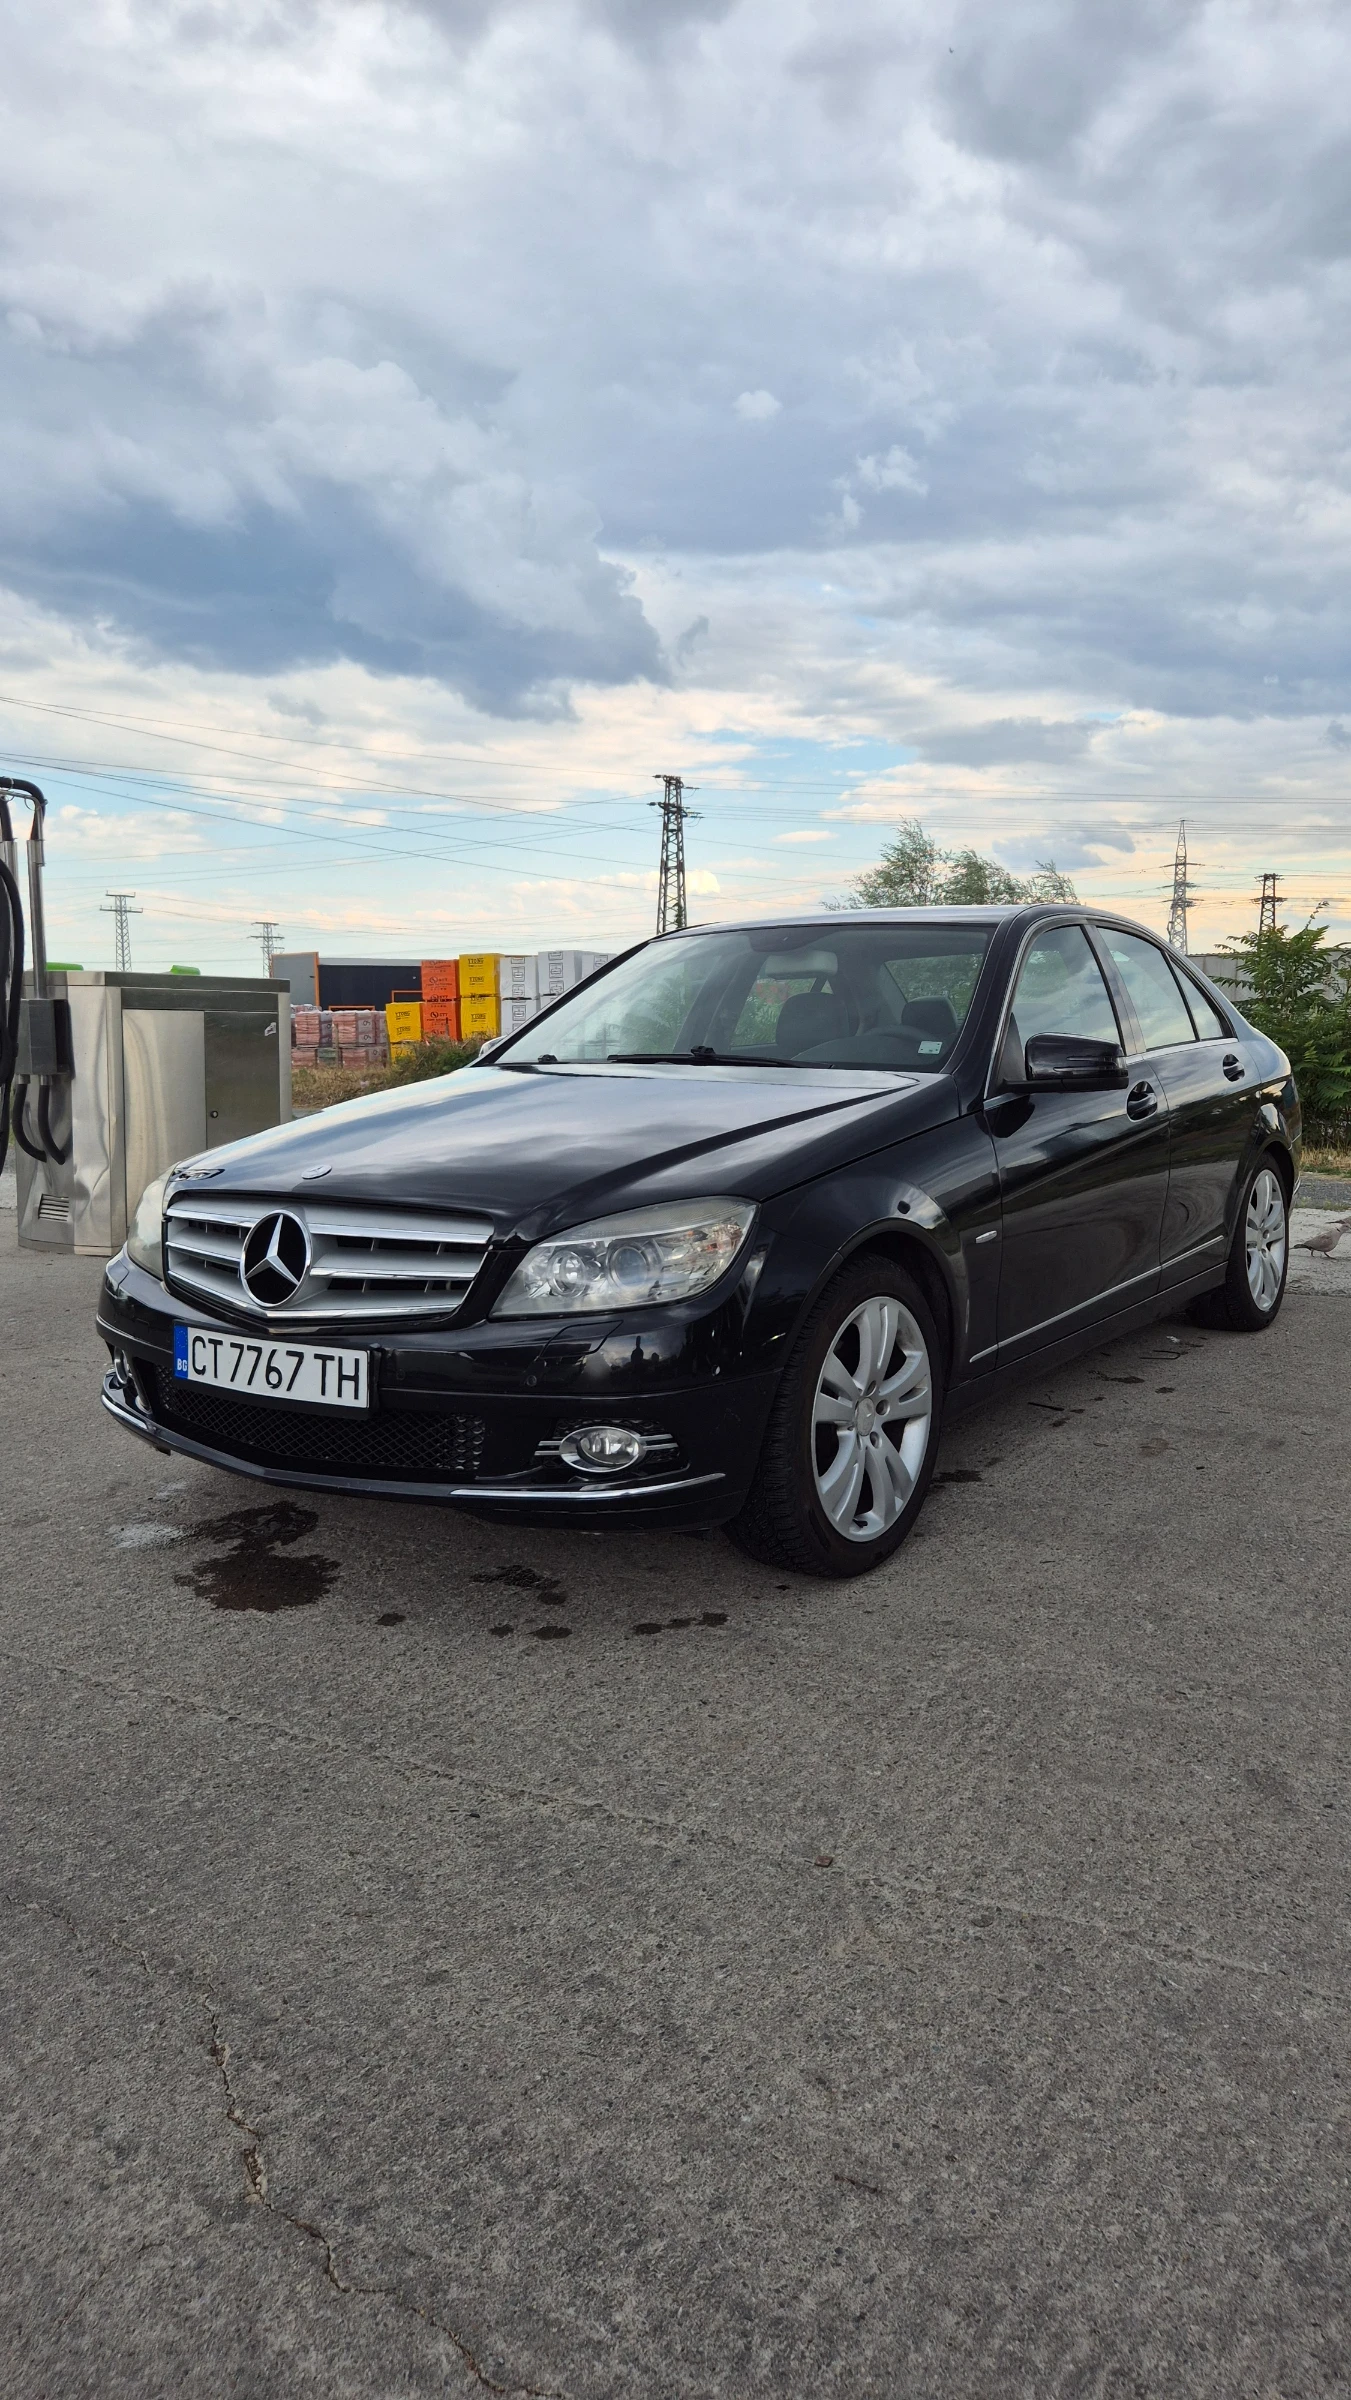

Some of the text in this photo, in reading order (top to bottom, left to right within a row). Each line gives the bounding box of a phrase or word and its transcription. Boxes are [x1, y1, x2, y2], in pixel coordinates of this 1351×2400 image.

[177, 1358, 188, 1371] BG
[192, 1335, 360, 1400] CT 7767 TH
